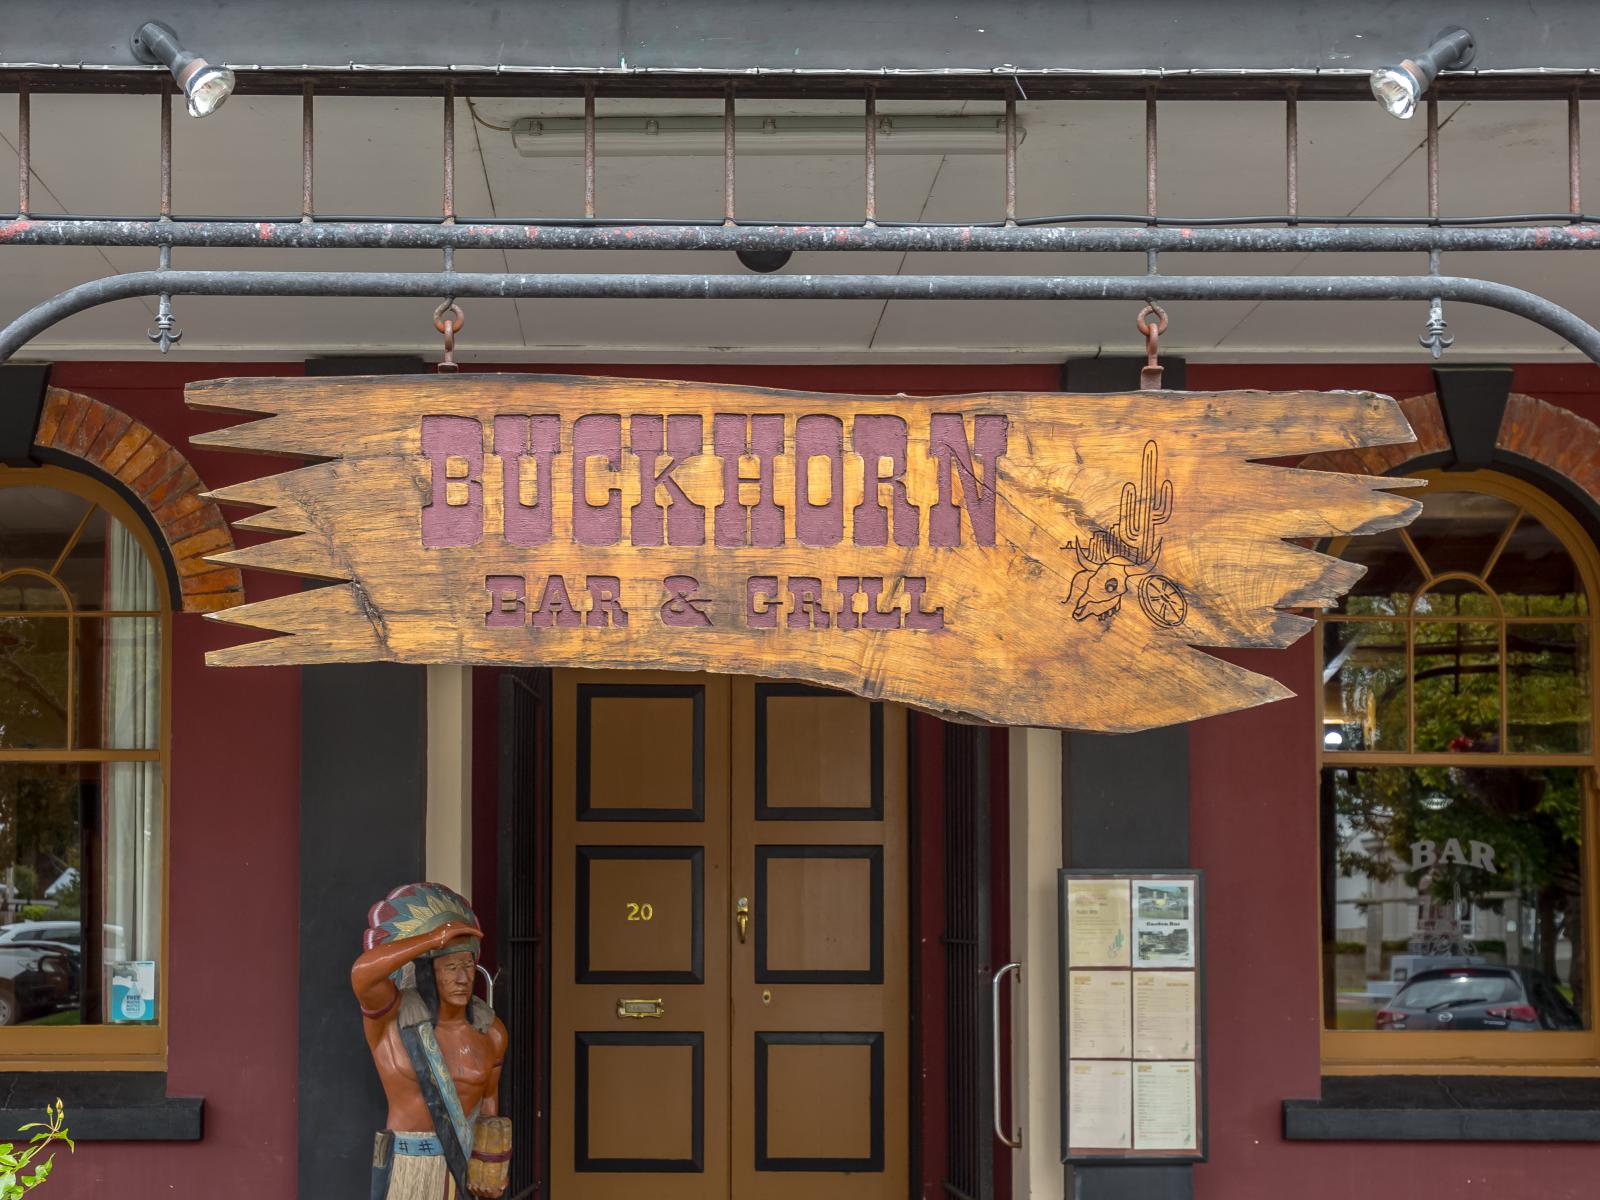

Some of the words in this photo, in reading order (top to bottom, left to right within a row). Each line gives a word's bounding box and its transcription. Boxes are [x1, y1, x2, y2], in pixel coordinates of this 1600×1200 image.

[421, 413, 1009, 547] BUCKHORN
[485, 575, 629, 629] BAR
[661, 575, 712, 627] &
[746, 575, 945, 630] GRILL
[1410, 838, 1497, 874] BAR
[626, 902, 653, 921] 20
